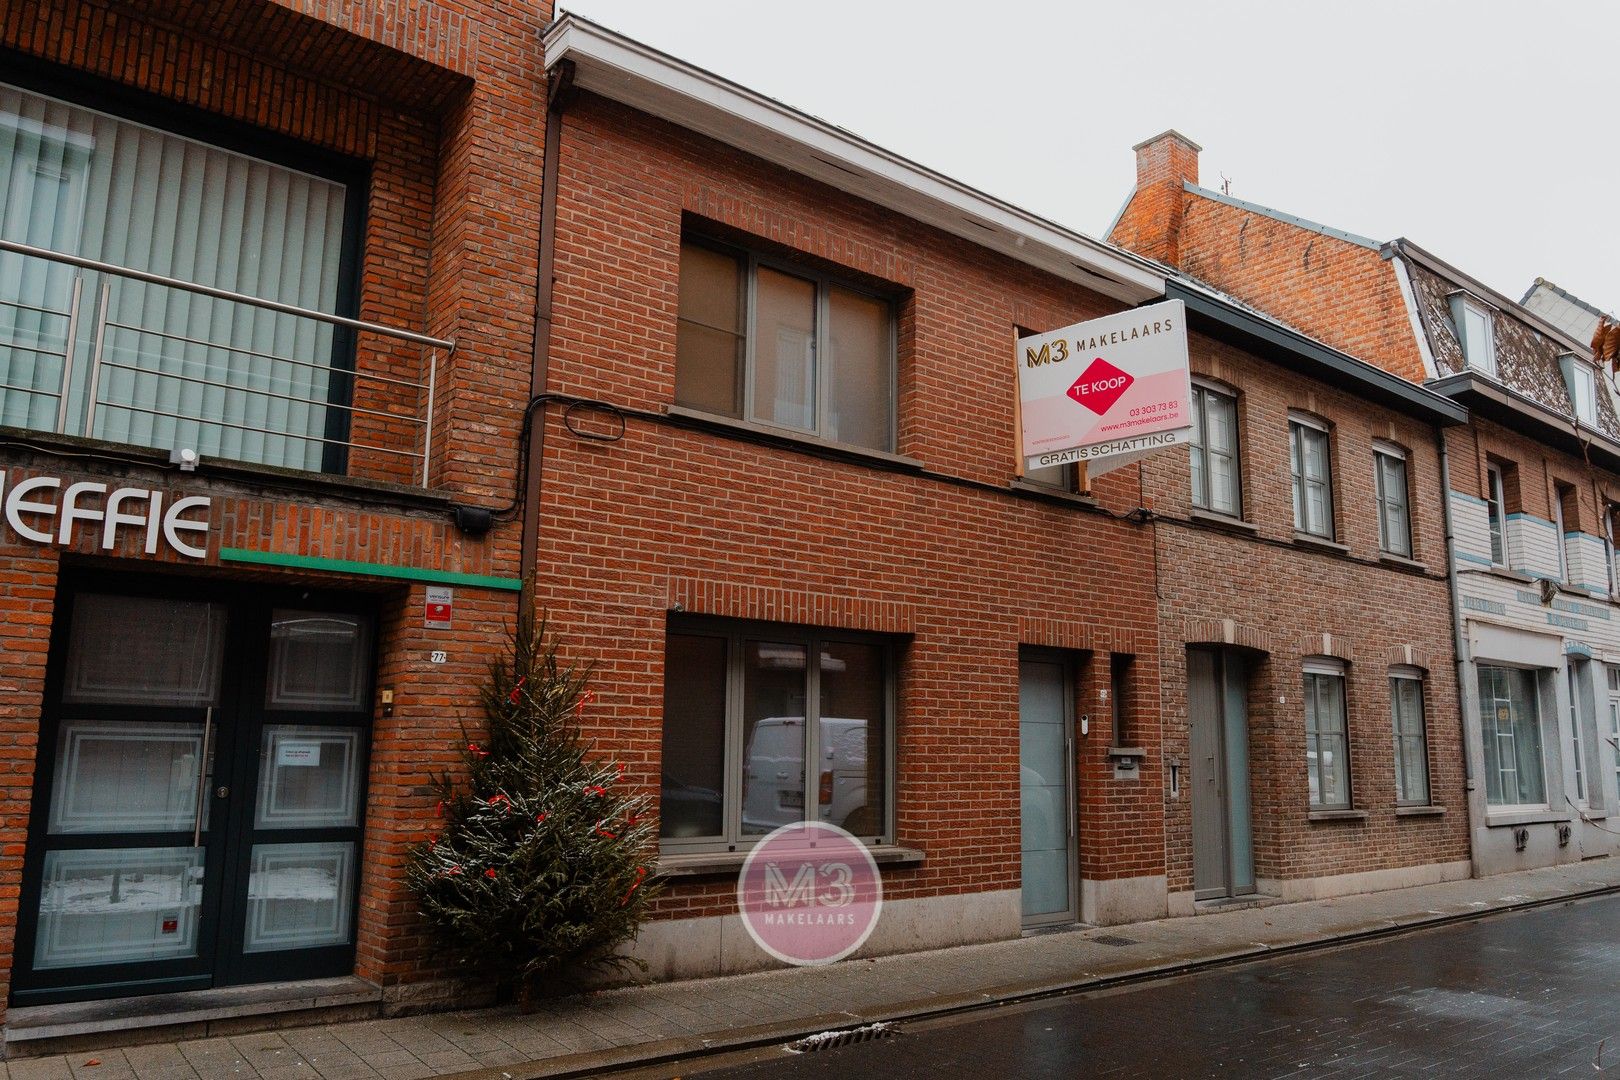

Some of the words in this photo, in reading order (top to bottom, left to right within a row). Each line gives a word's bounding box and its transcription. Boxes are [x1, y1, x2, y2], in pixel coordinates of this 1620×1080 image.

[1026, 339, 1069, 368] M3
[1077, 319, 1172, 352] MAKELAARS
[1074, 384, 1089, 397] TE
[1092, 376, 1126, 393] KOOP
[1130, 407, 1140, 417] 03
[1142, 404, 1156, 415] 303
[1158, 402, 1167, 412] 73
[1168, 401, 1178, 410] 83
[1101, 412, 1178, 432] www.m3makelaars.be
[1040, 449, 1088, 466] GRATIS
[1092, 433, 1176, 456] SCHATTING
[0, 471, 211, 559] EFFIE
[434, 652, 444, 662] 77
